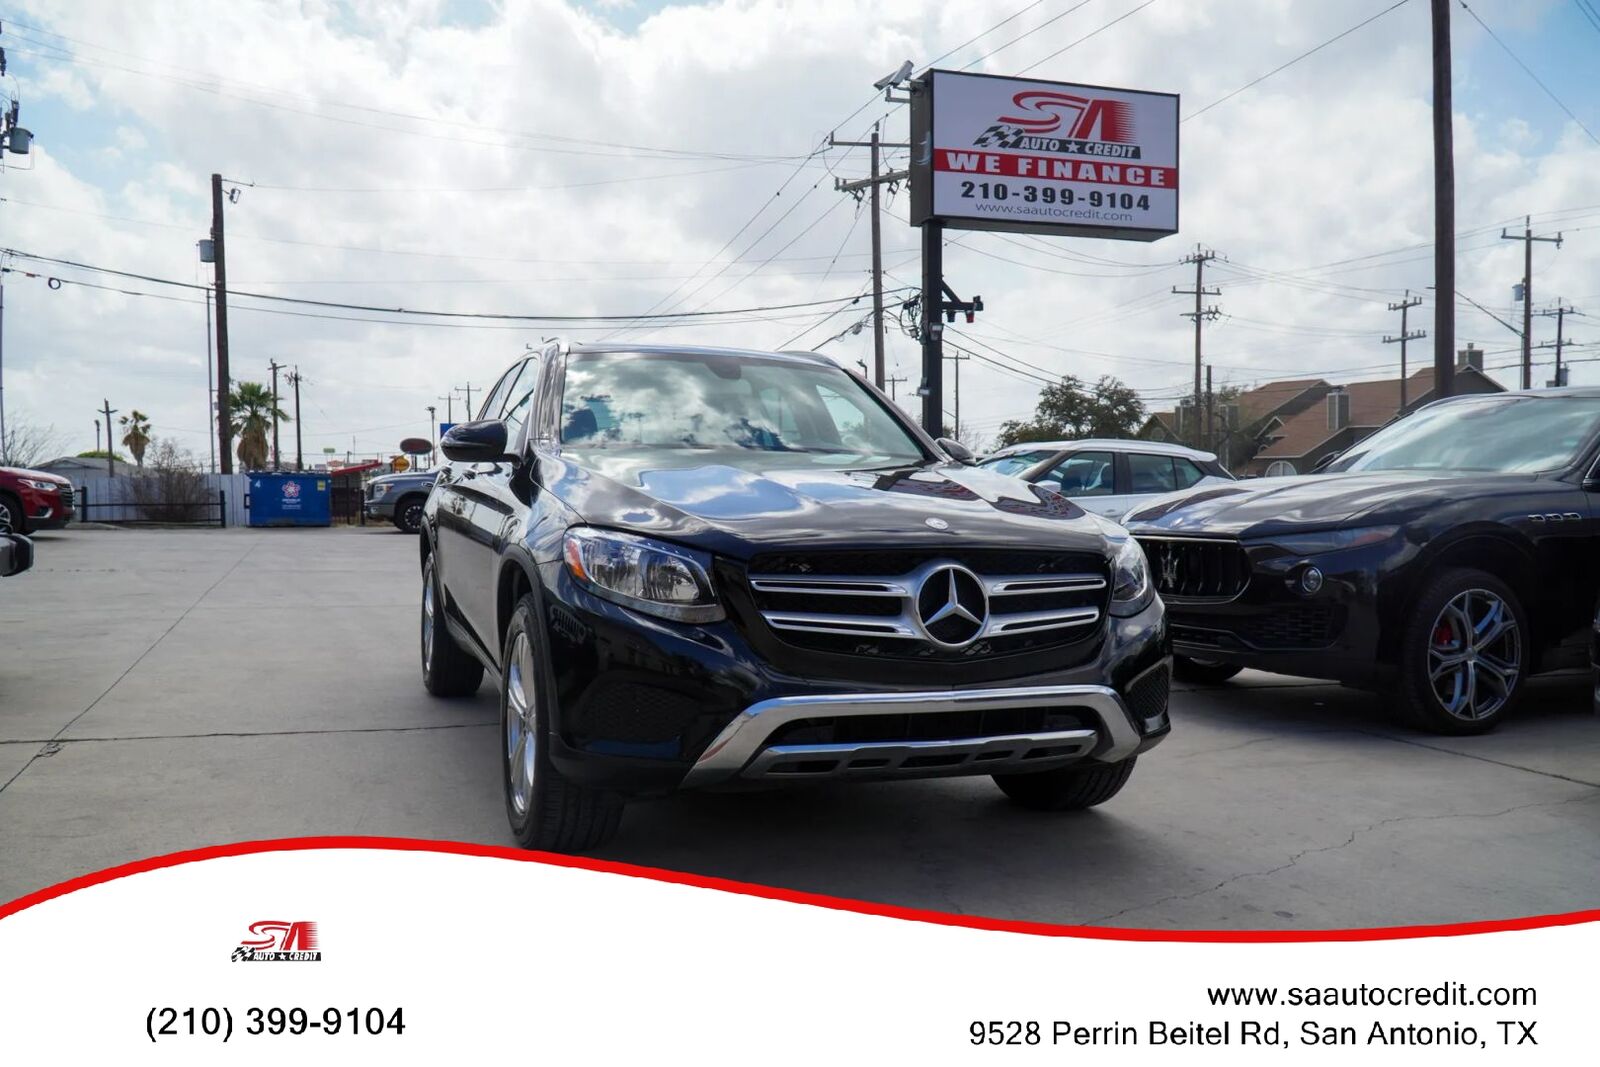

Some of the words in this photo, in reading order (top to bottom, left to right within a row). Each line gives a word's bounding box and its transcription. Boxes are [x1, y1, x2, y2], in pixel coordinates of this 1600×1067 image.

[997, 91, 1137, 143] SA
[1019, 137, 1060, 152] AUTO
[1084, 143, 1136, 158] CREDIT
[946, 152, 1001, 173] WE
[1017, 158, 1166, 186] FINANCE
[961, 181, 1149, 211] 210-399-9104
[975, 202, 1133, 222] www.saautocredit.com
